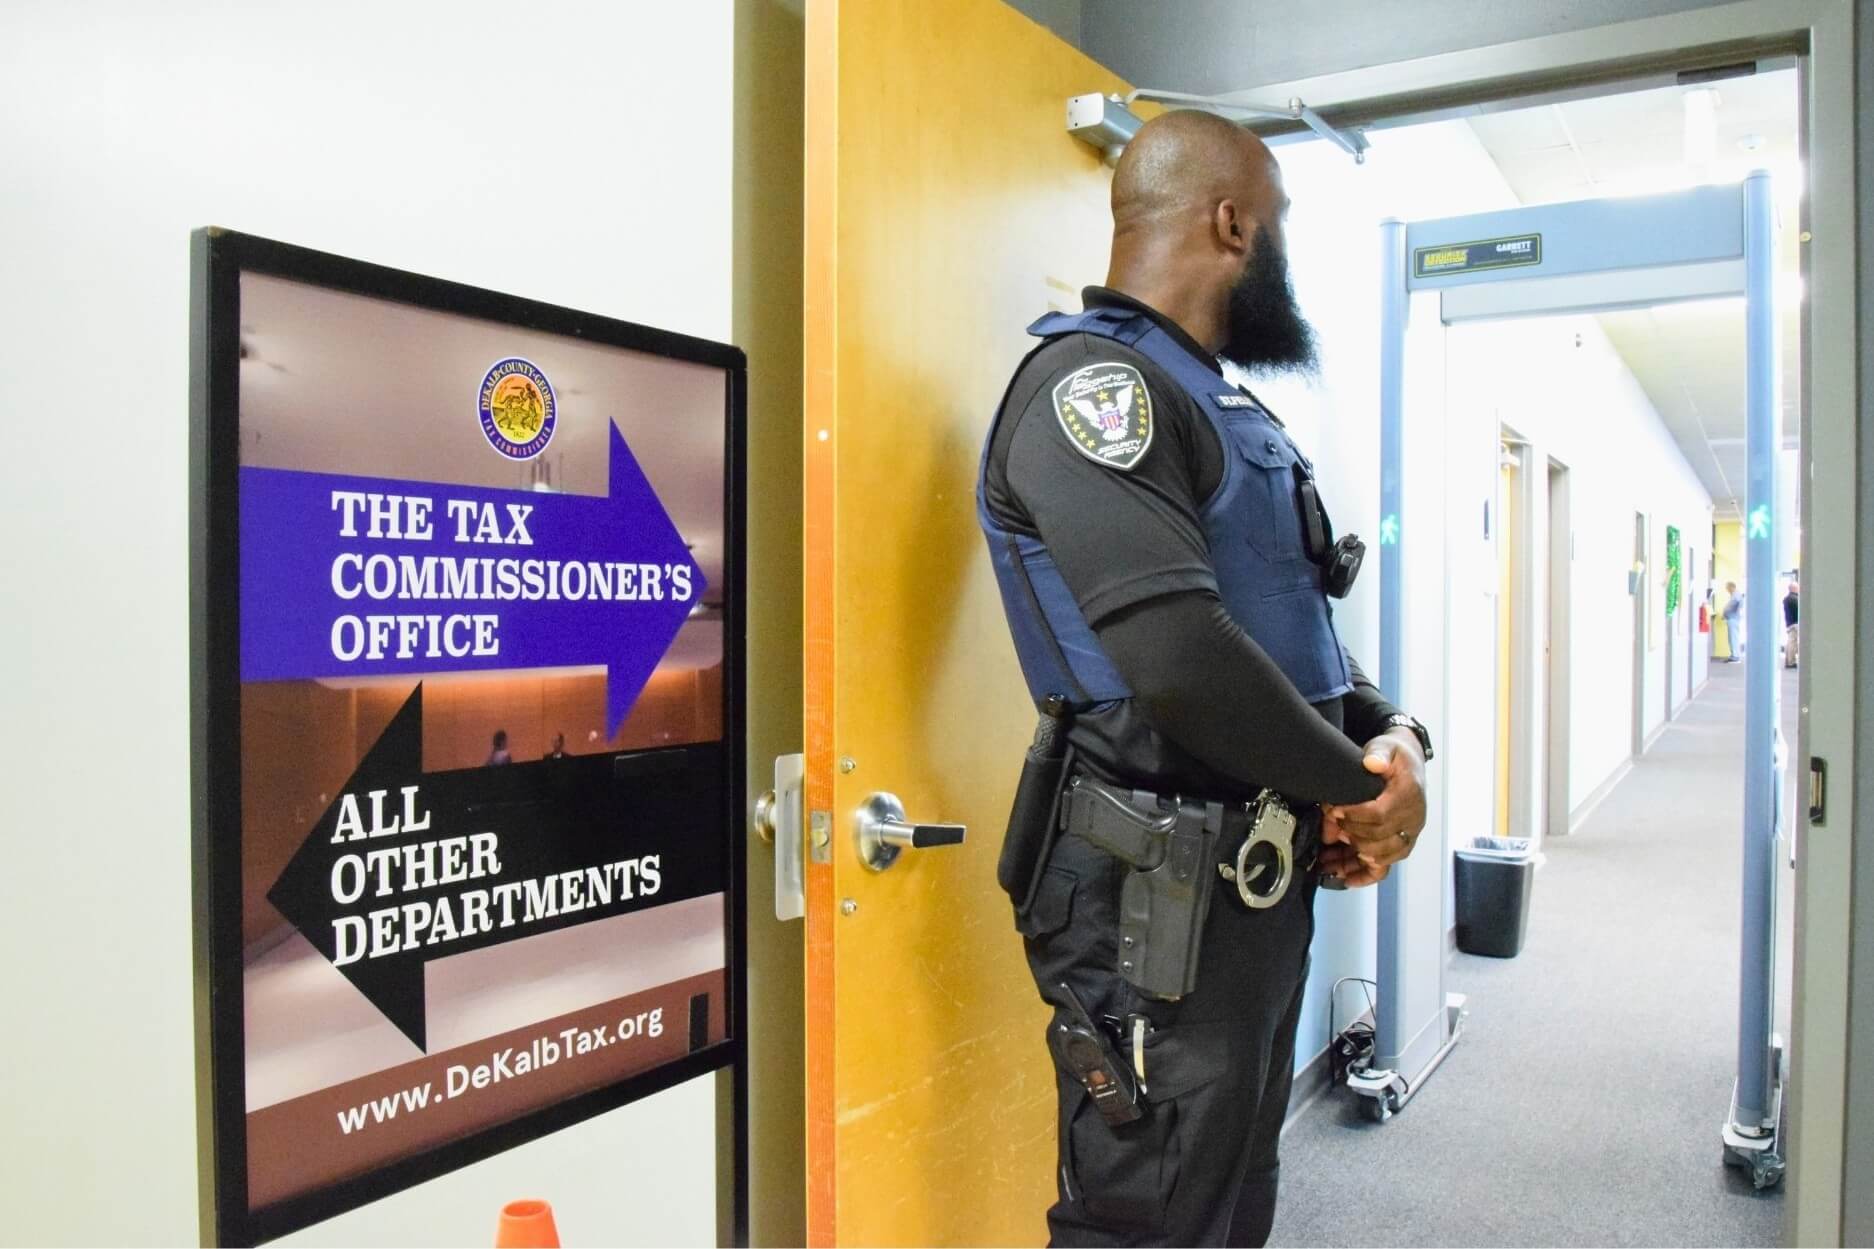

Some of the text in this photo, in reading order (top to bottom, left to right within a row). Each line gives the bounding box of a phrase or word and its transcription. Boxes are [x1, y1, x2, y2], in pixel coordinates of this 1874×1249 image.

[499, 360, 535, 377] COUNTY
[533, 374, 554, 419] GEORGIA
[331, 490, 534, 545] THE TAX
[331, 552, 692, 602] COMMISSIONER'S
[331, 614, 499, 662] OFFICE
[330, 785, 431, 844] ALL
[331, 832, 502, 904] OTHER
[331, 854, 661, 968] DEPARTMENTS
[337, 1007, 664, 1135] www.DeKalbTax.org
